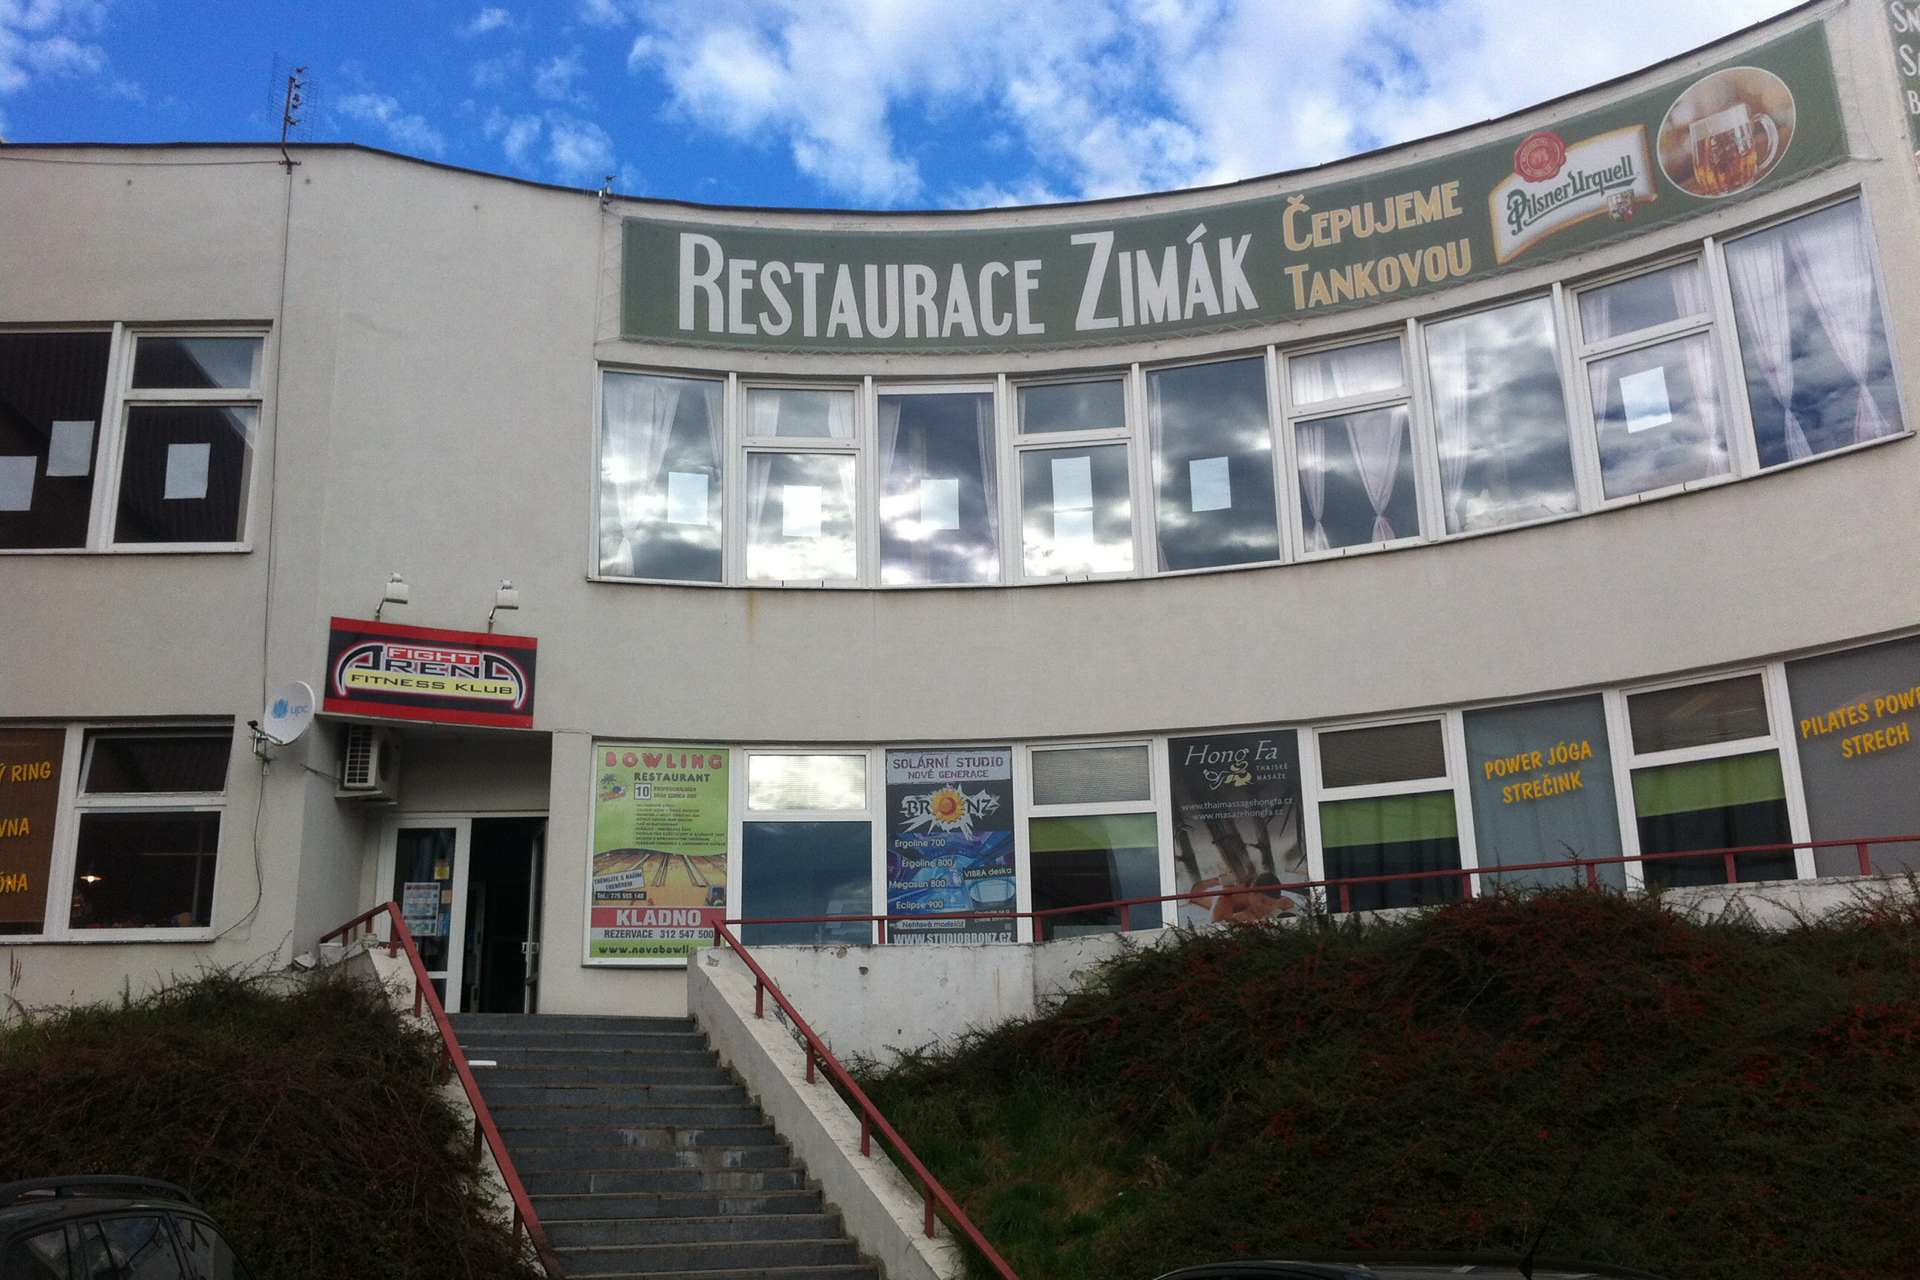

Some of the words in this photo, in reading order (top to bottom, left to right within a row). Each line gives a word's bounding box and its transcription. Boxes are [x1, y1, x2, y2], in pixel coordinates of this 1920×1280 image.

[1507, 188, 1572, 236] Pilsner
[1567, 155, 1635, 197] Urquell
[1282, 181, 1462, 252] ČEPUJEME
[678, 232, 1045, 339] RESTAURACE
[1070, 222, 1260, 332] ZIMÁK
[1284, 238, 1472, 310] TANKOVOU
[387, 648, 478, 664] FIGHT
[338, 645, 524, 694] ARENA
[351, 674, 445, 690] FITNESS
[455, 683, 513, 695] KLUB
[290, 705, 309, 717] upc
[1801, 703, 1870, 739] PILATES
[1842, 722, 1910, 758] STRECH
[605, 751, 723, 770] BOWLING
[893, 755, 949, 769] SOLÁRNÍ
[956, 757, 1004, 768] STUDIO
[1184, 744, 1249, 771] Hong
[1255, 740, 1278, 761] Fa
[1485, 751, 1543, 780] POWER
[1548, 741, 1594, 766] JÓGA
[12, 761, 51, 782] RING
[634, 772, 711, 782] RESTAURANT
[908, 769, 934, 779] NOVÉ
[938, 770, 989, 779] GENERACE
[635, 786, 651, 797] 10
[1503, 770, 1584, 804] STREČINK
[1181, 797, 1293, 811] www.thaimassagehongfa.cz
[1192, 809, 1284, 820] www.masazehongfa.cz
[895, 840, 929, 849] Ergoline
[930, 839, 946, 847] 700
[902, 859, 935, 870] Ergoline
[964, 870, 987, 878] VIBRA
[988, 868, 1012, 876] deska
[889, 880, 929, 890] Megasun
[931, 880, 946, 888] 800
[896, 901, 928, 909] Eclipse
[928, 901, 944, 909] 900
[616, 909, 702, 926] KLADNO
[902, 920, 932, 928] Nehtová
[604, 929, 654, 939] REZERVACE
[660, 930, 676, 939] 312
[679, 930, 695, 939] 547
[698, 930, 714, 939] 500
[893, 932, 1012, 944] WWW.STUDIOBRONZ.CZ
[598, 944, 694, 954] www.novobowli
